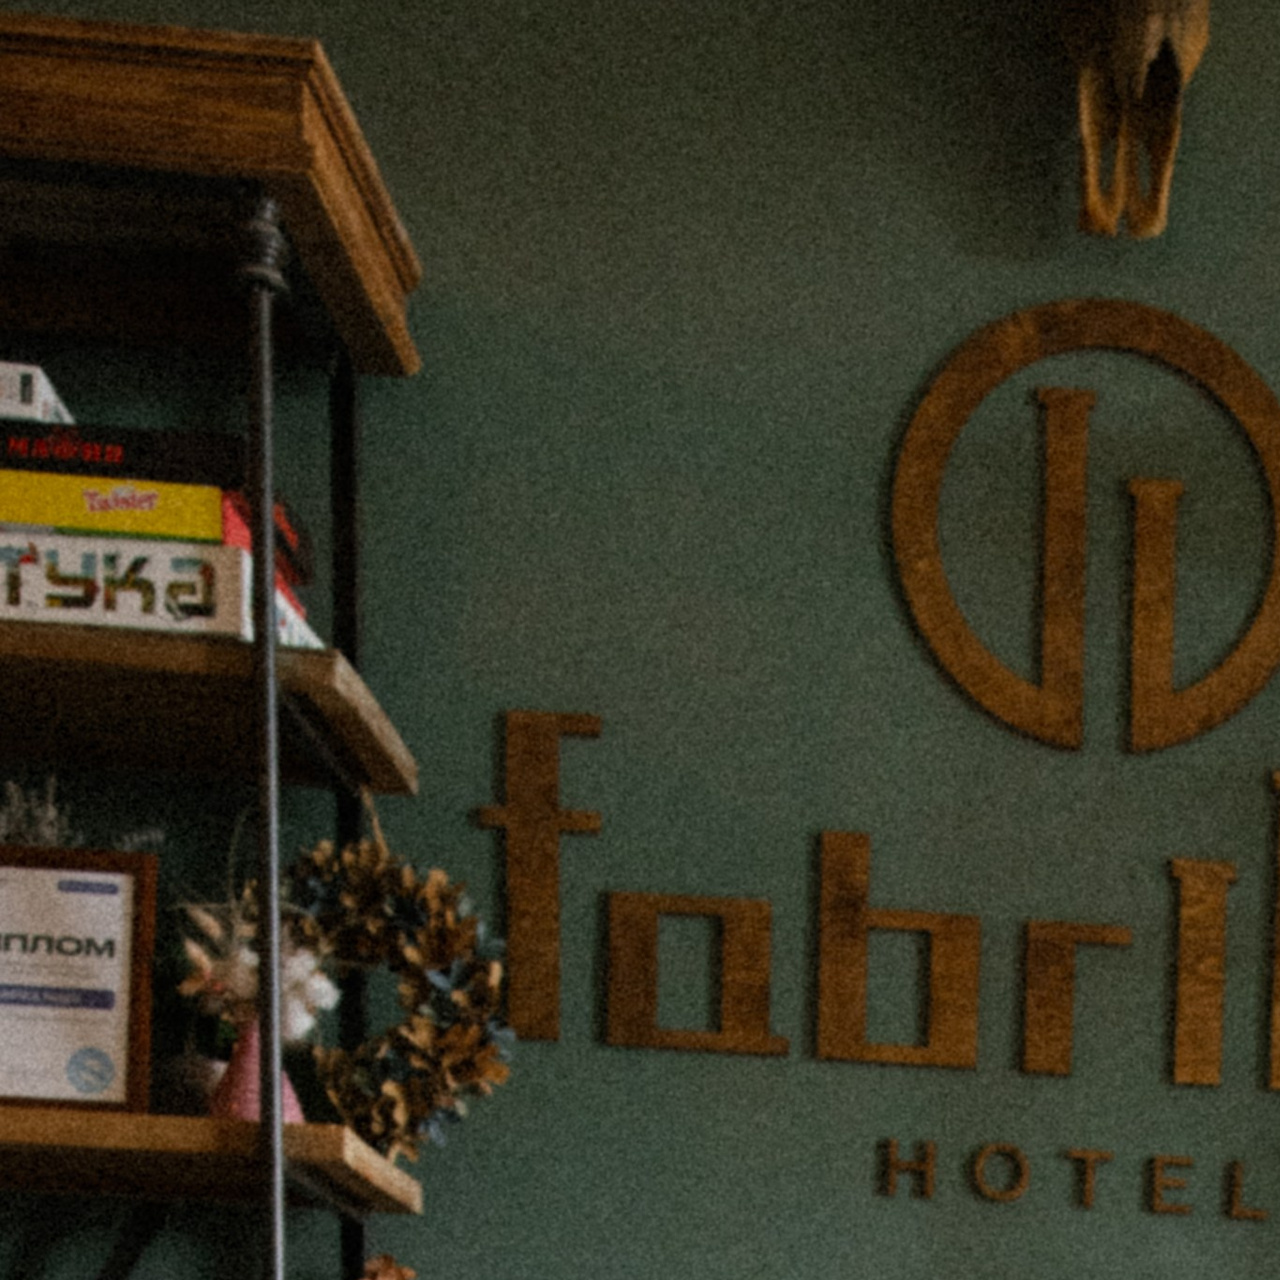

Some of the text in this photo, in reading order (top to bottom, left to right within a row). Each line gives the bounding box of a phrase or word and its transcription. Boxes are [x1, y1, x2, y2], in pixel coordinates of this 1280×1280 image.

[83, 488, 159, 512] Twister
[0, 932, 116, 959] ПЛОМ
[877, 1138, 1270, 1222] HOTEL
